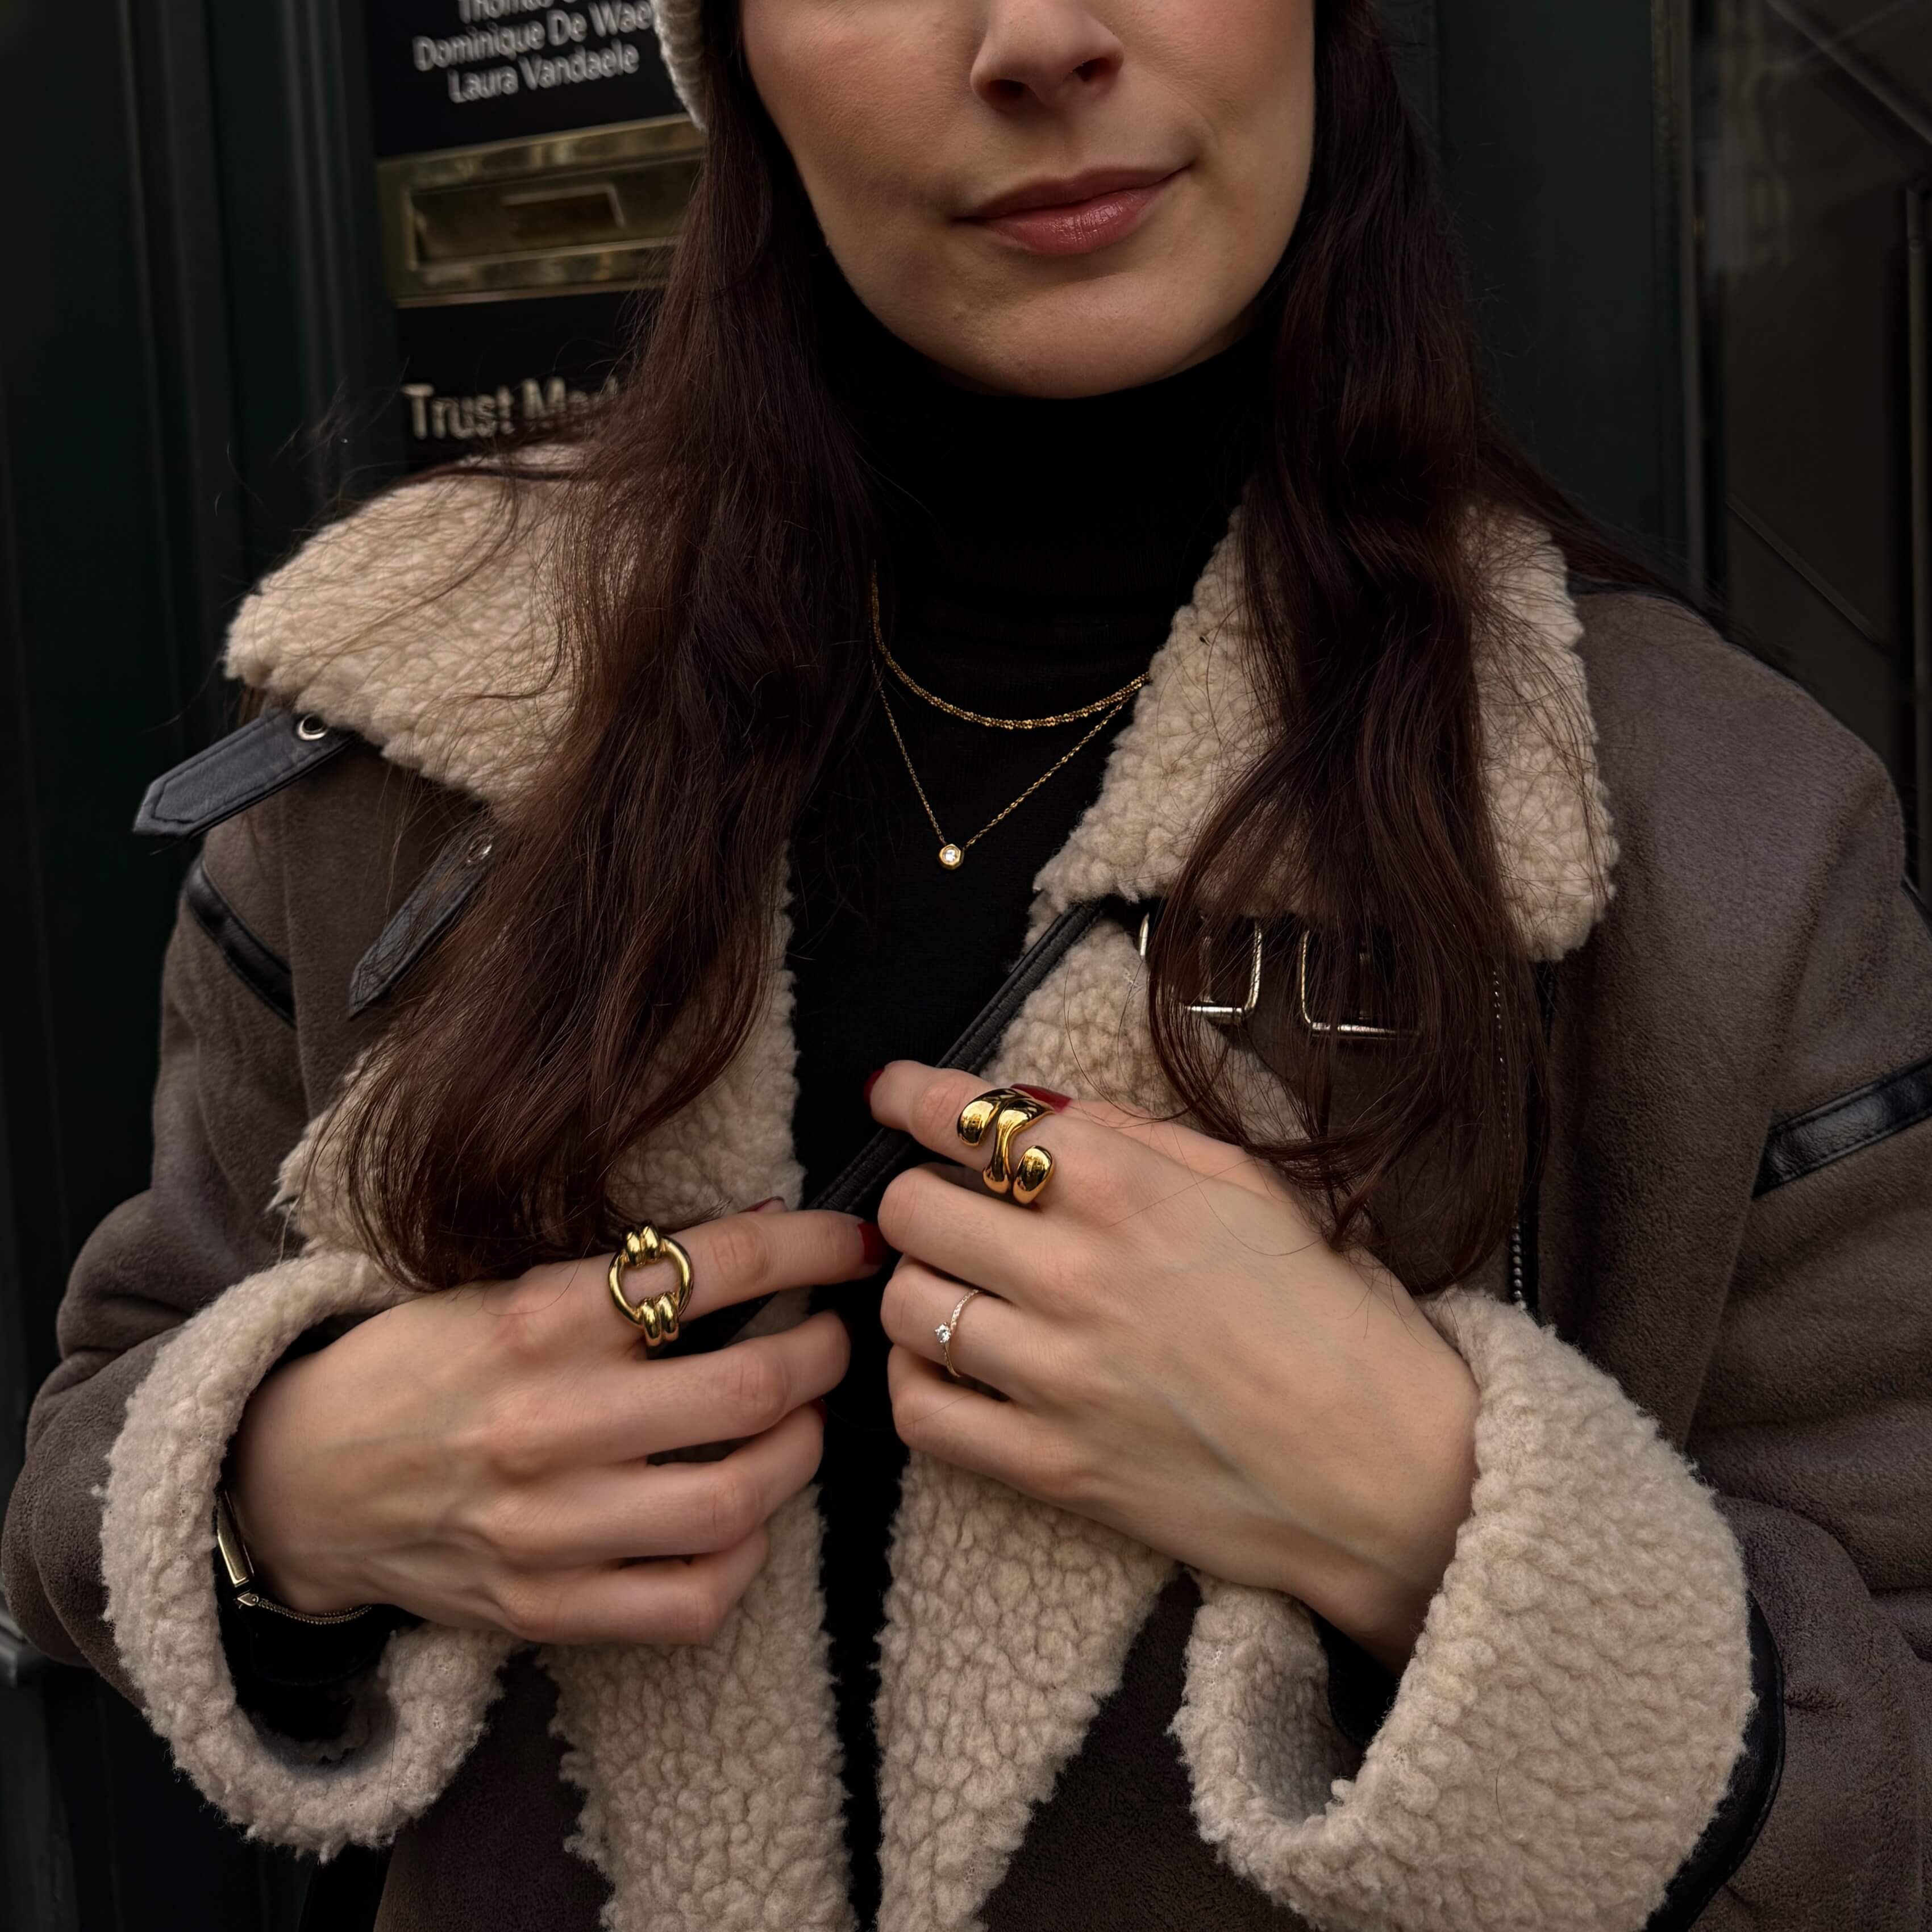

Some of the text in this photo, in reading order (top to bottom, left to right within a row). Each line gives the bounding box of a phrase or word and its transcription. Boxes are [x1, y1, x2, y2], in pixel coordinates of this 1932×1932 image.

[413, 20, 545, 71] Dominique
[546, 9, 588, 45] De
[448, 39, 639, 103] Laura Vandaele
[401, 384, 514, 440] Trust
